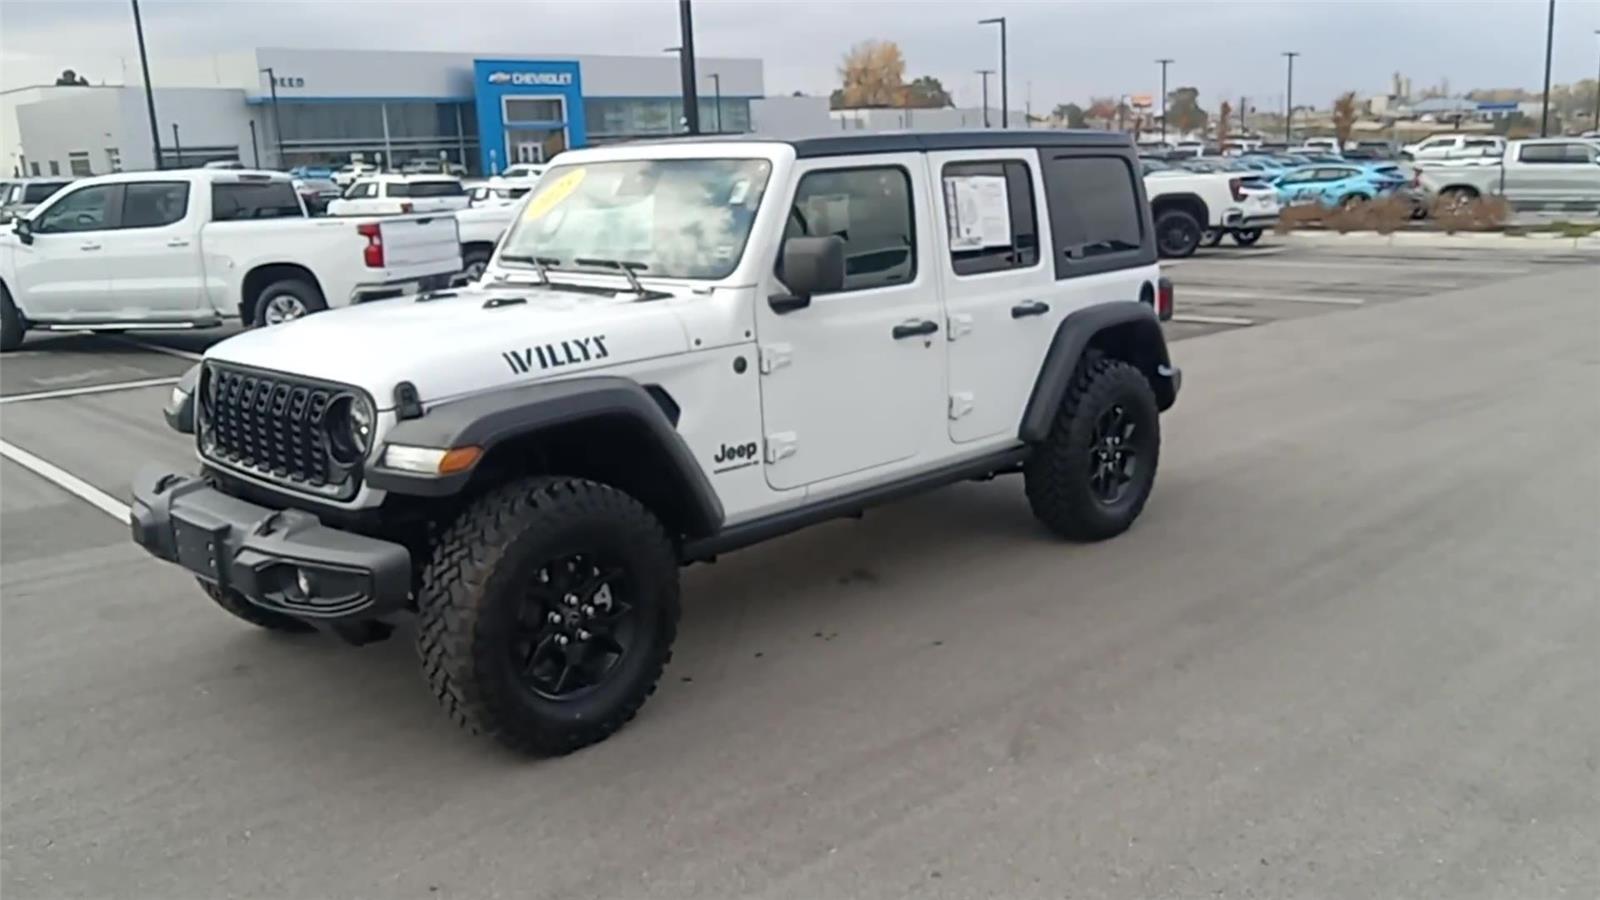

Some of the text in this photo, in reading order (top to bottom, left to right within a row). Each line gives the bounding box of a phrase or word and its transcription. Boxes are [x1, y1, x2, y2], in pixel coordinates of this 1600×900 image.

[512, 73, 573, 85] CHEVROLET
[502, 334, 609, 375] WILLYS
[713, 441, 758, 464] Jeep
